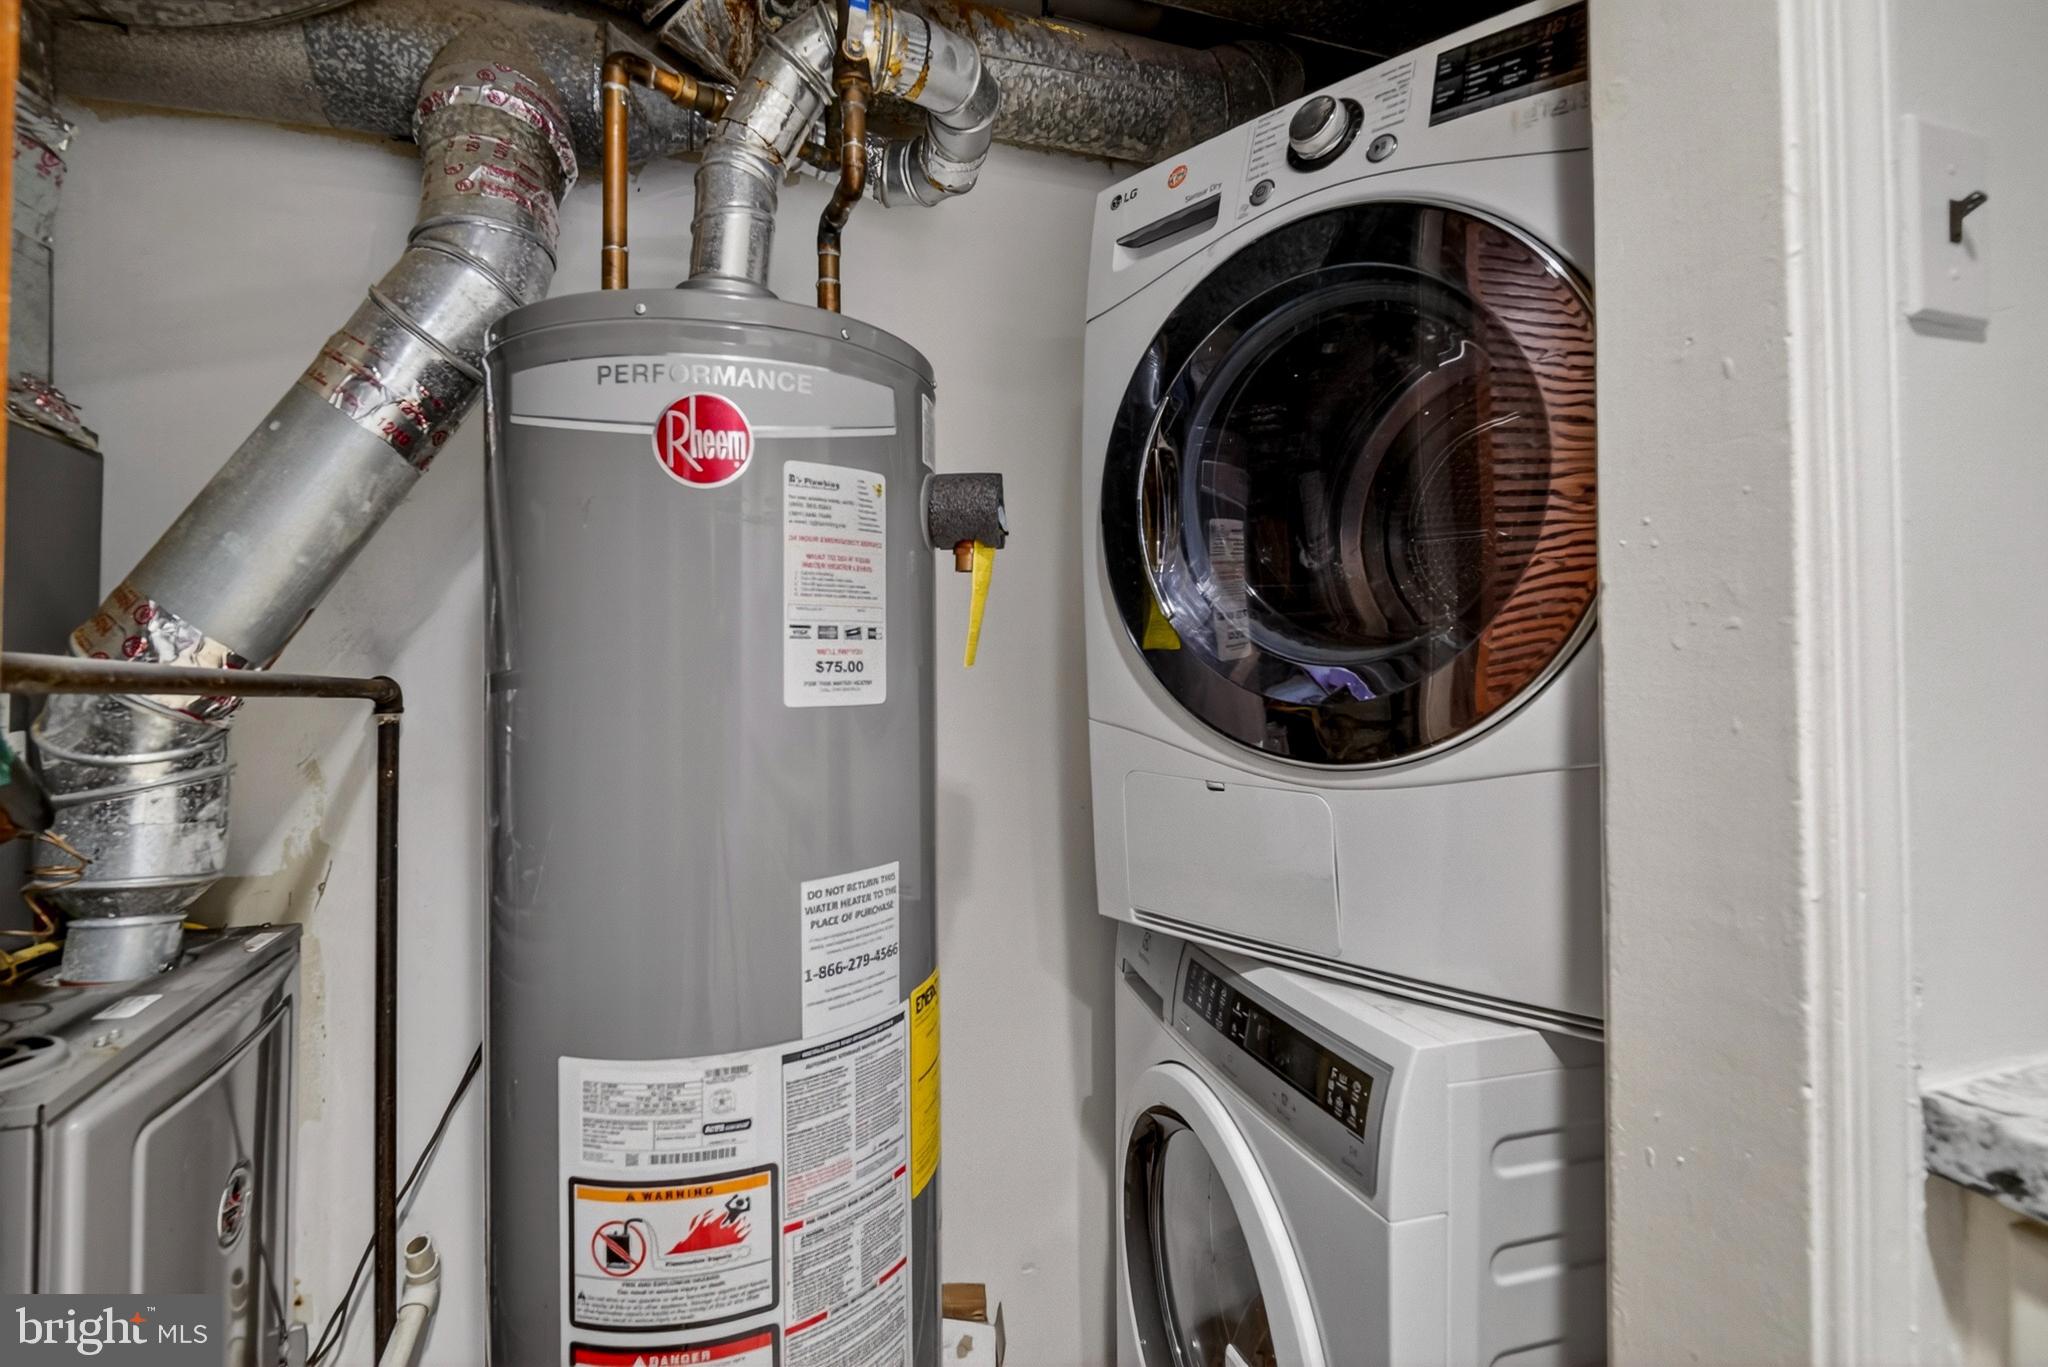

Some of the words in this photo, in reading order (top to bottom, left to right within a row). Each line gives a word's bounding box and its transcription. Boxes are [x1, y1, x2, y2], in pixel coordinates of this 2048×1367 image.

[1123, 188, 1139, 203] LG
[597, 363, 813, 395] PERFORMANCE
[665, 394, 748, 472] Rheem
[815, 660, 864, 673] $75.00
[804, 900, 838, 915] WATER
[840, 892, 872, 908] HEATER
[873, 889, 884, 899] TO
[884, 885, 897, 896] THE
[807, 889, 823, 900] DO
[825, 884, 845, 896] NOT
[846, 877, 879, 892] RETURN
[880, 872, 896, 883] THIS
[810, 914, 840, 929] PLACE
[841, 911, 853, 923] OF
[854, 900, 894, 918] PURCHASE
[804, 942, 899, 982] 1-866-279-4566
[641, 1186, 715, 1201] WARNING
[649, 1350, 711, 1367] DANGER
